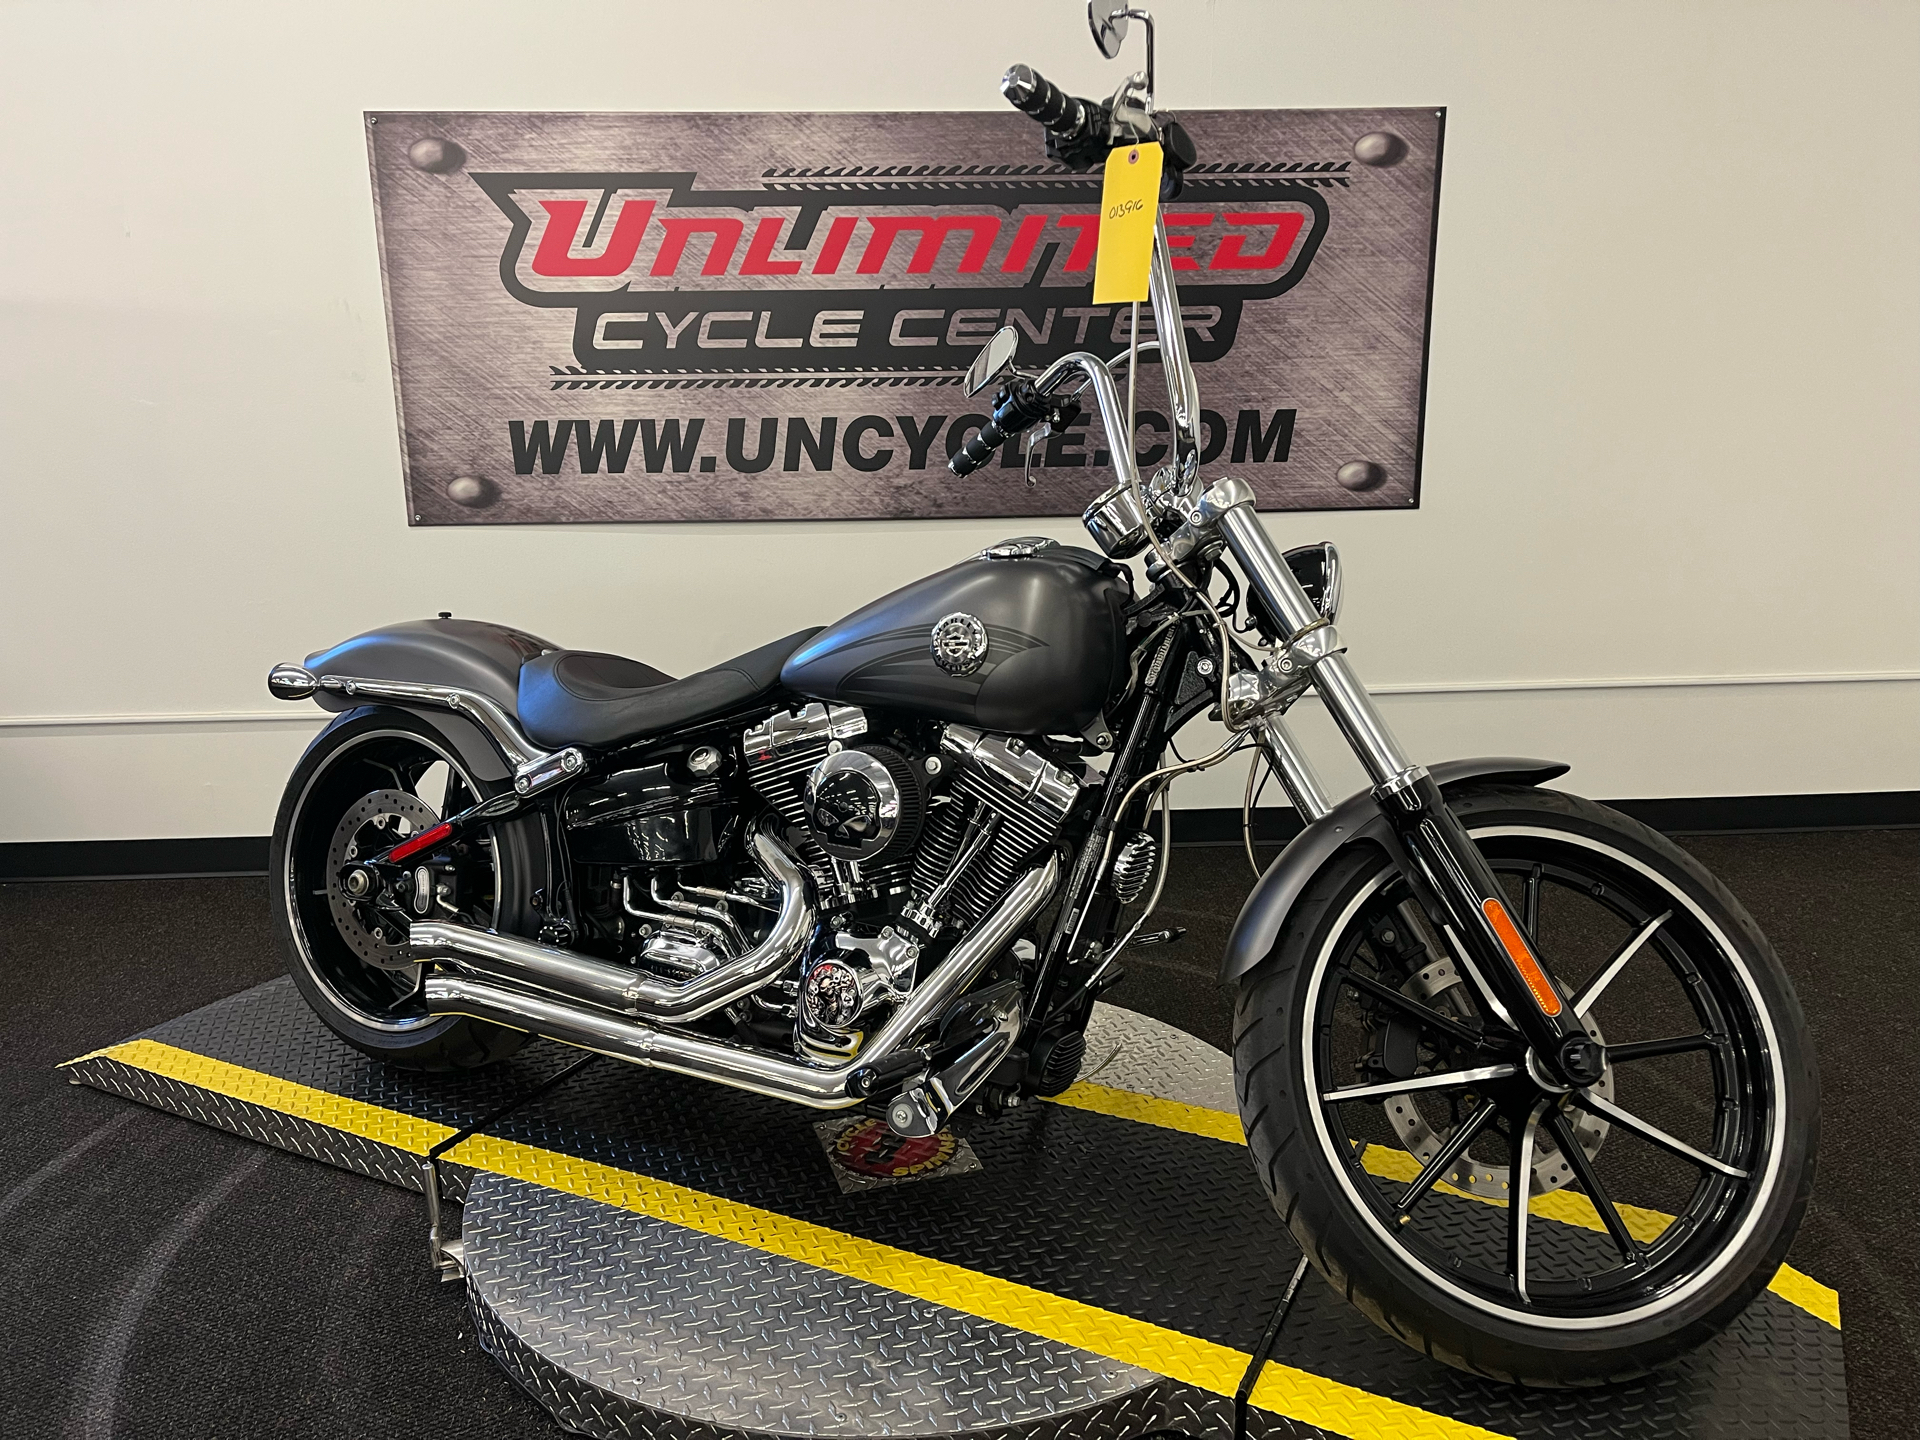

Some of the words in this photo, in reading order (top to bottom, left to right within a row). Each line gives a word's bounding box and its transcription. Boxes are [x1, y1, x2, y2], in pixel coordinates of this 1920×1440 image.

[591, 310, 864, 349] CYCLE
[888, 305, 1222, 347] CENTER
[836, 1119, 877, 1151] CYCLE
